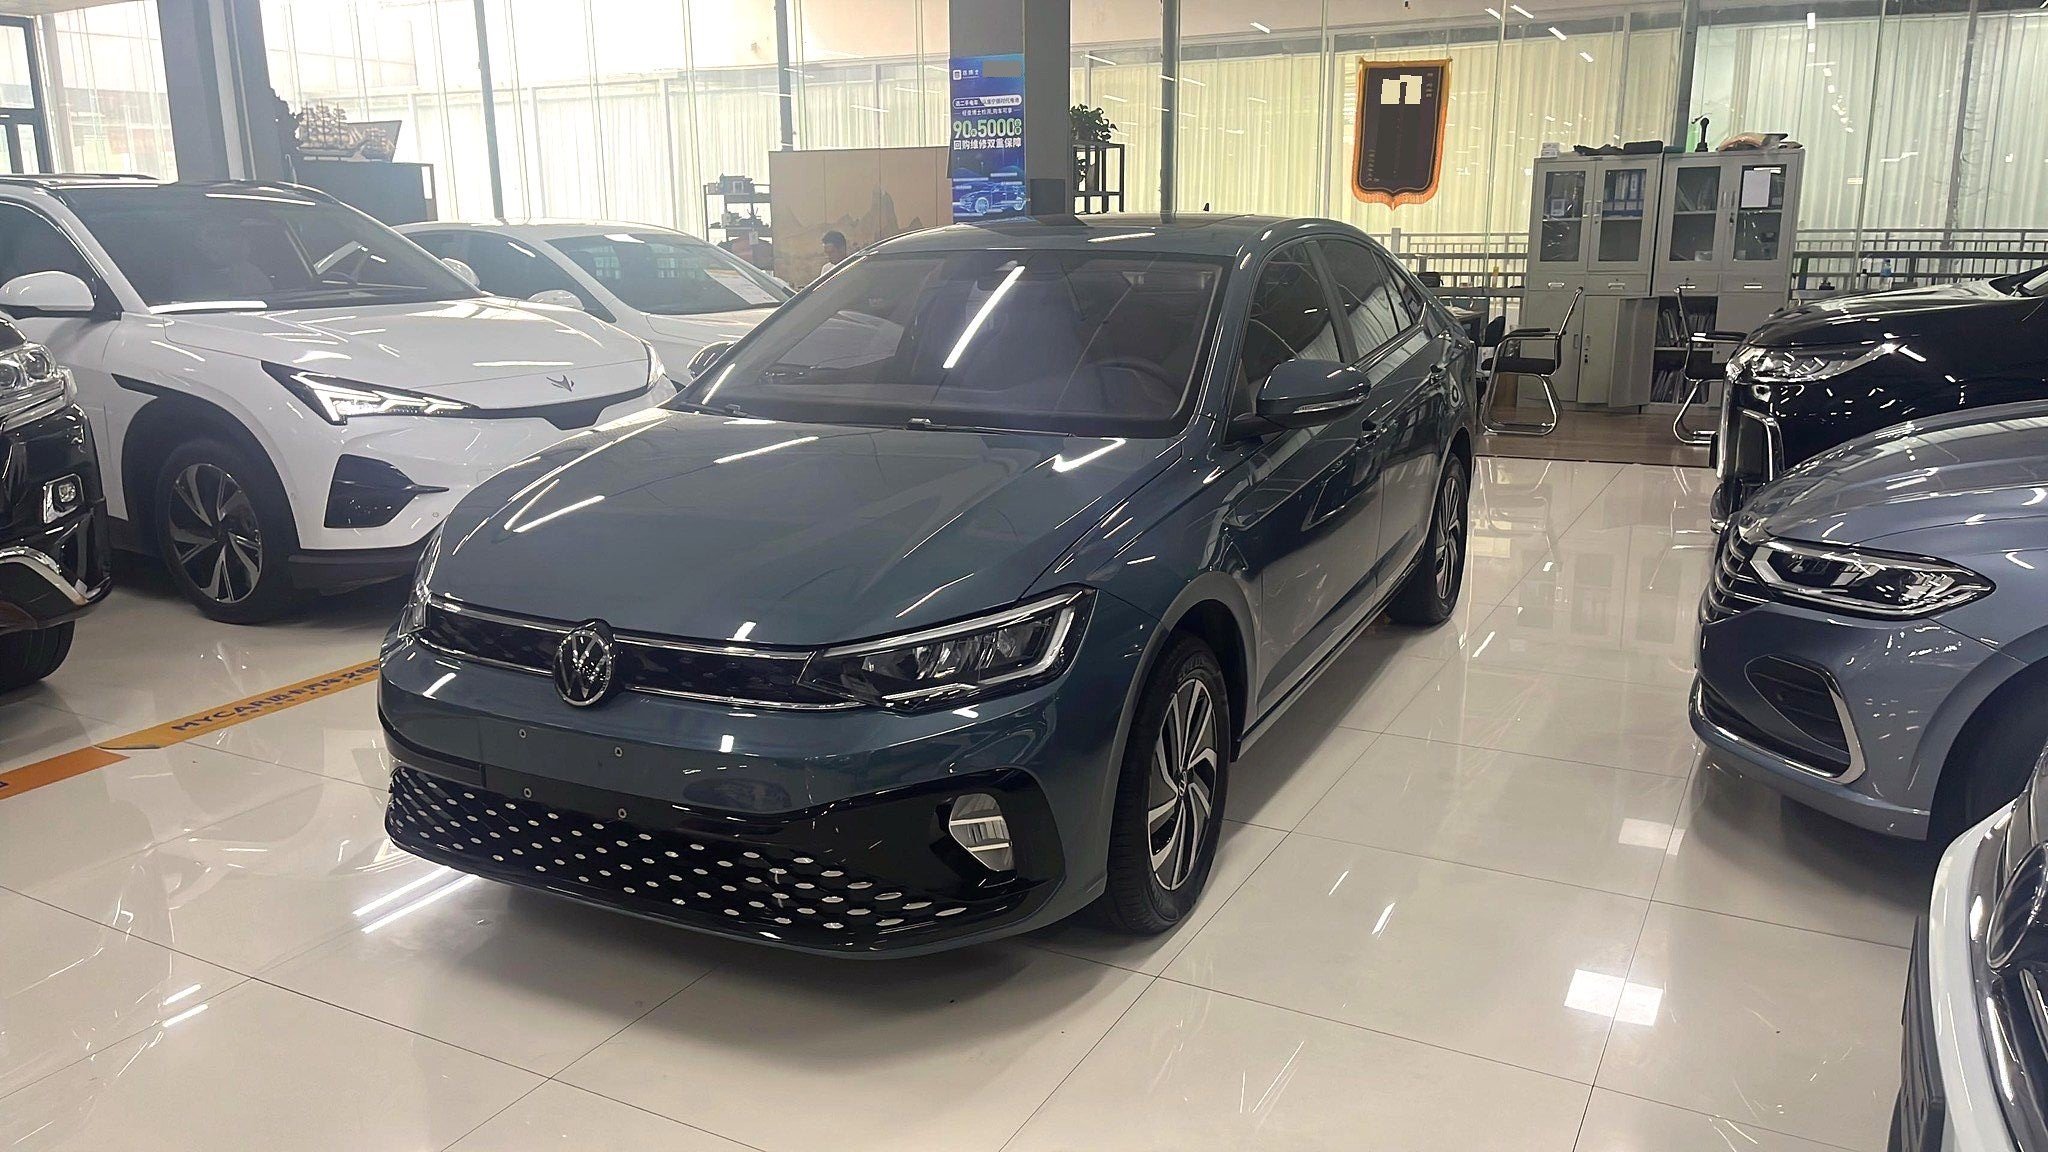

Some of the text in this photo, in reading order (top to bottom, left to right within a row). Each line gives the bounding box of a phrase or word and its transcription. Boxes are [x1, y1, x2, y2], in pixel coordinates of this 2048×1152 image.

[954, 137, 1022, 150] 回购维修双重保障
